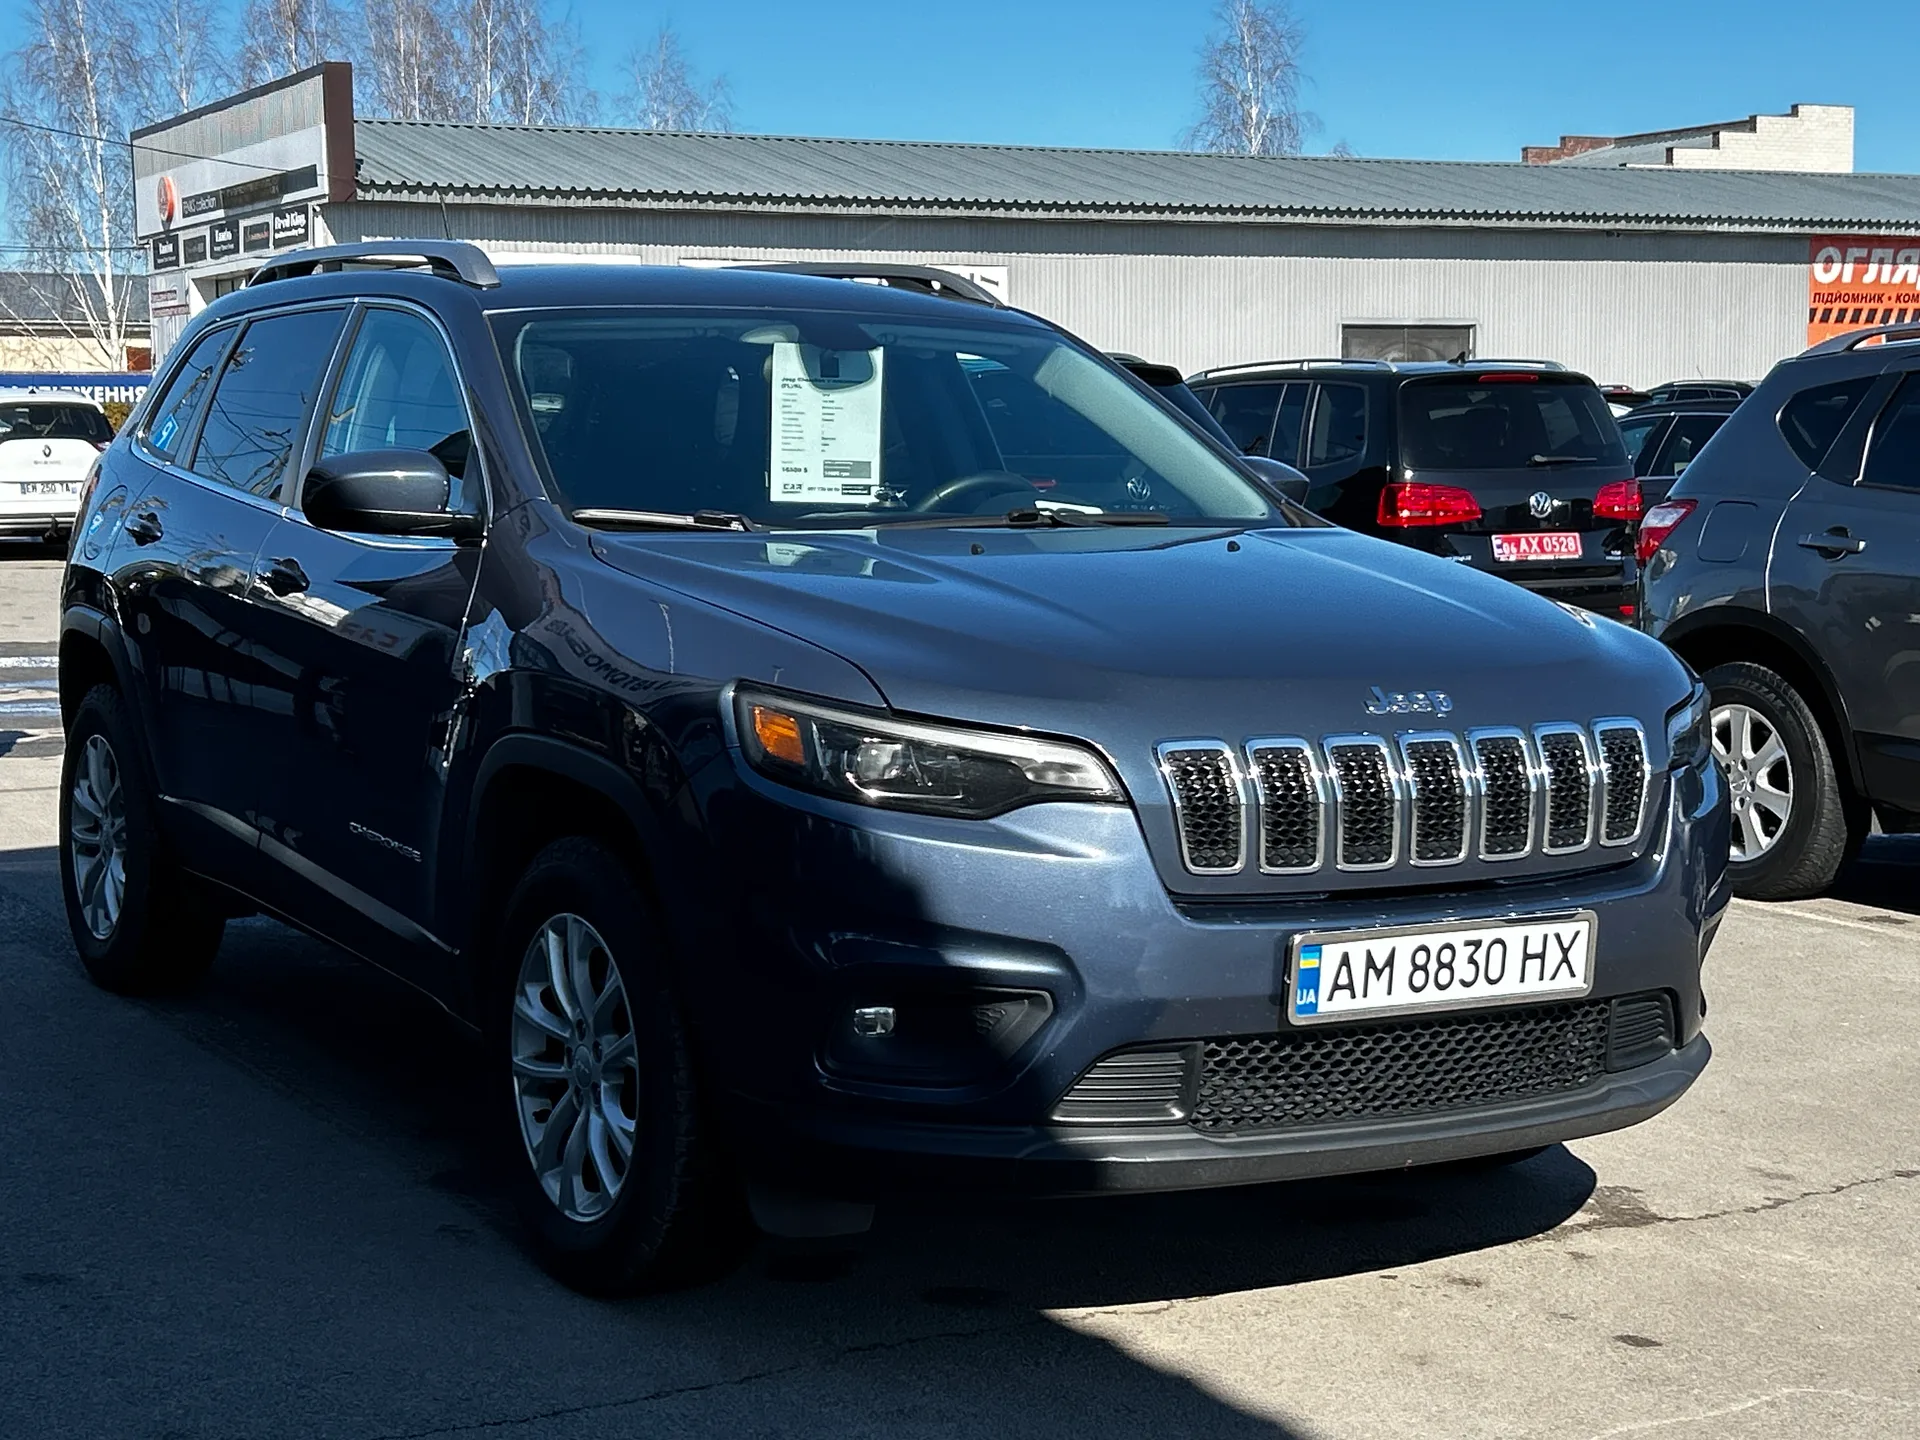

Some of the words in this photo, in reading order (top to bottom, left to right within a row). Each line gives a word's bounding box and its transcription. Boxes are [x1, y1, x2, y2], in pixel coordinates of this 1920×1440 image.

[1813, 247, 1920, 290] ОГЛЯ
[1812, 291, 1885, 305] ПІДЙОМНИК
[1520, 537, 1540, 553] AX
[1543, 536, 1576, 552] 0528
[1362, 684, 1453, 718] Jeep
[349, 821, 422, 862] CHEROKEE
[1327, 946, 1396, 1002] AM
[1408, 938, 1507, 994] 8830
[1520, 930, 1581, 983] HX
[1296, 988, 1317, 1005] UA
